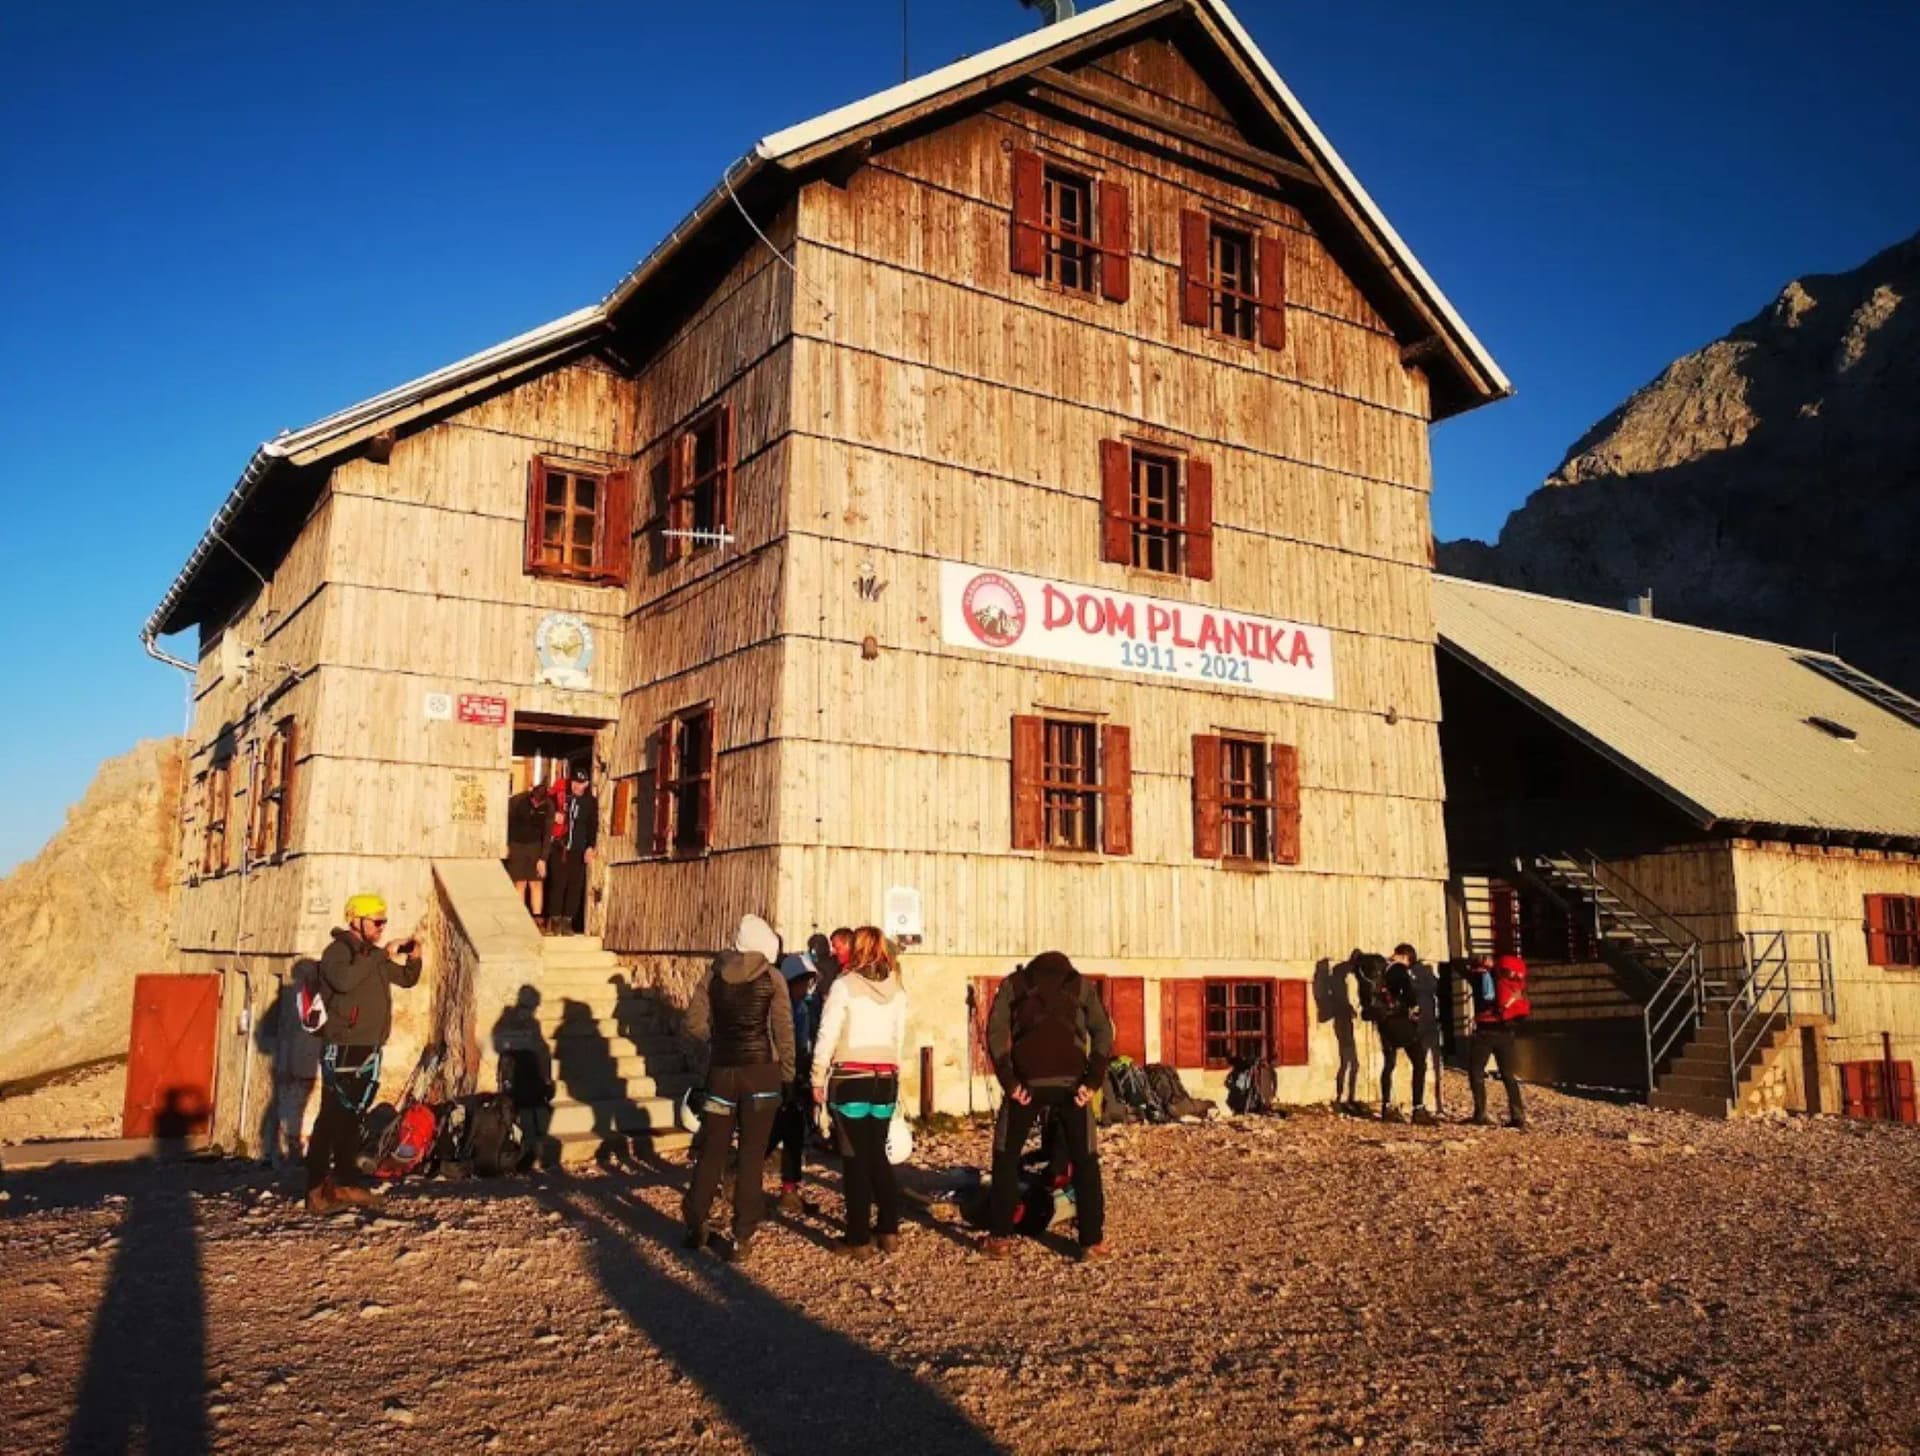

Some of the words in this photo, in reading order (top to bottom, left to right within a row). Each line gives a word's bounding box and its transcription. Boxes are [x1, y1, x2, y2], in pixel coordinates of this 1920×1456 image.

[1042, 583, 1136, 640] DOM
[1147, 604, 1314, 669] PLANIKA
[1120, 641, 1177, 673] 1911
[1185, 661, 1192, 669] -
[1200, 653, 1253, 683] 2021
